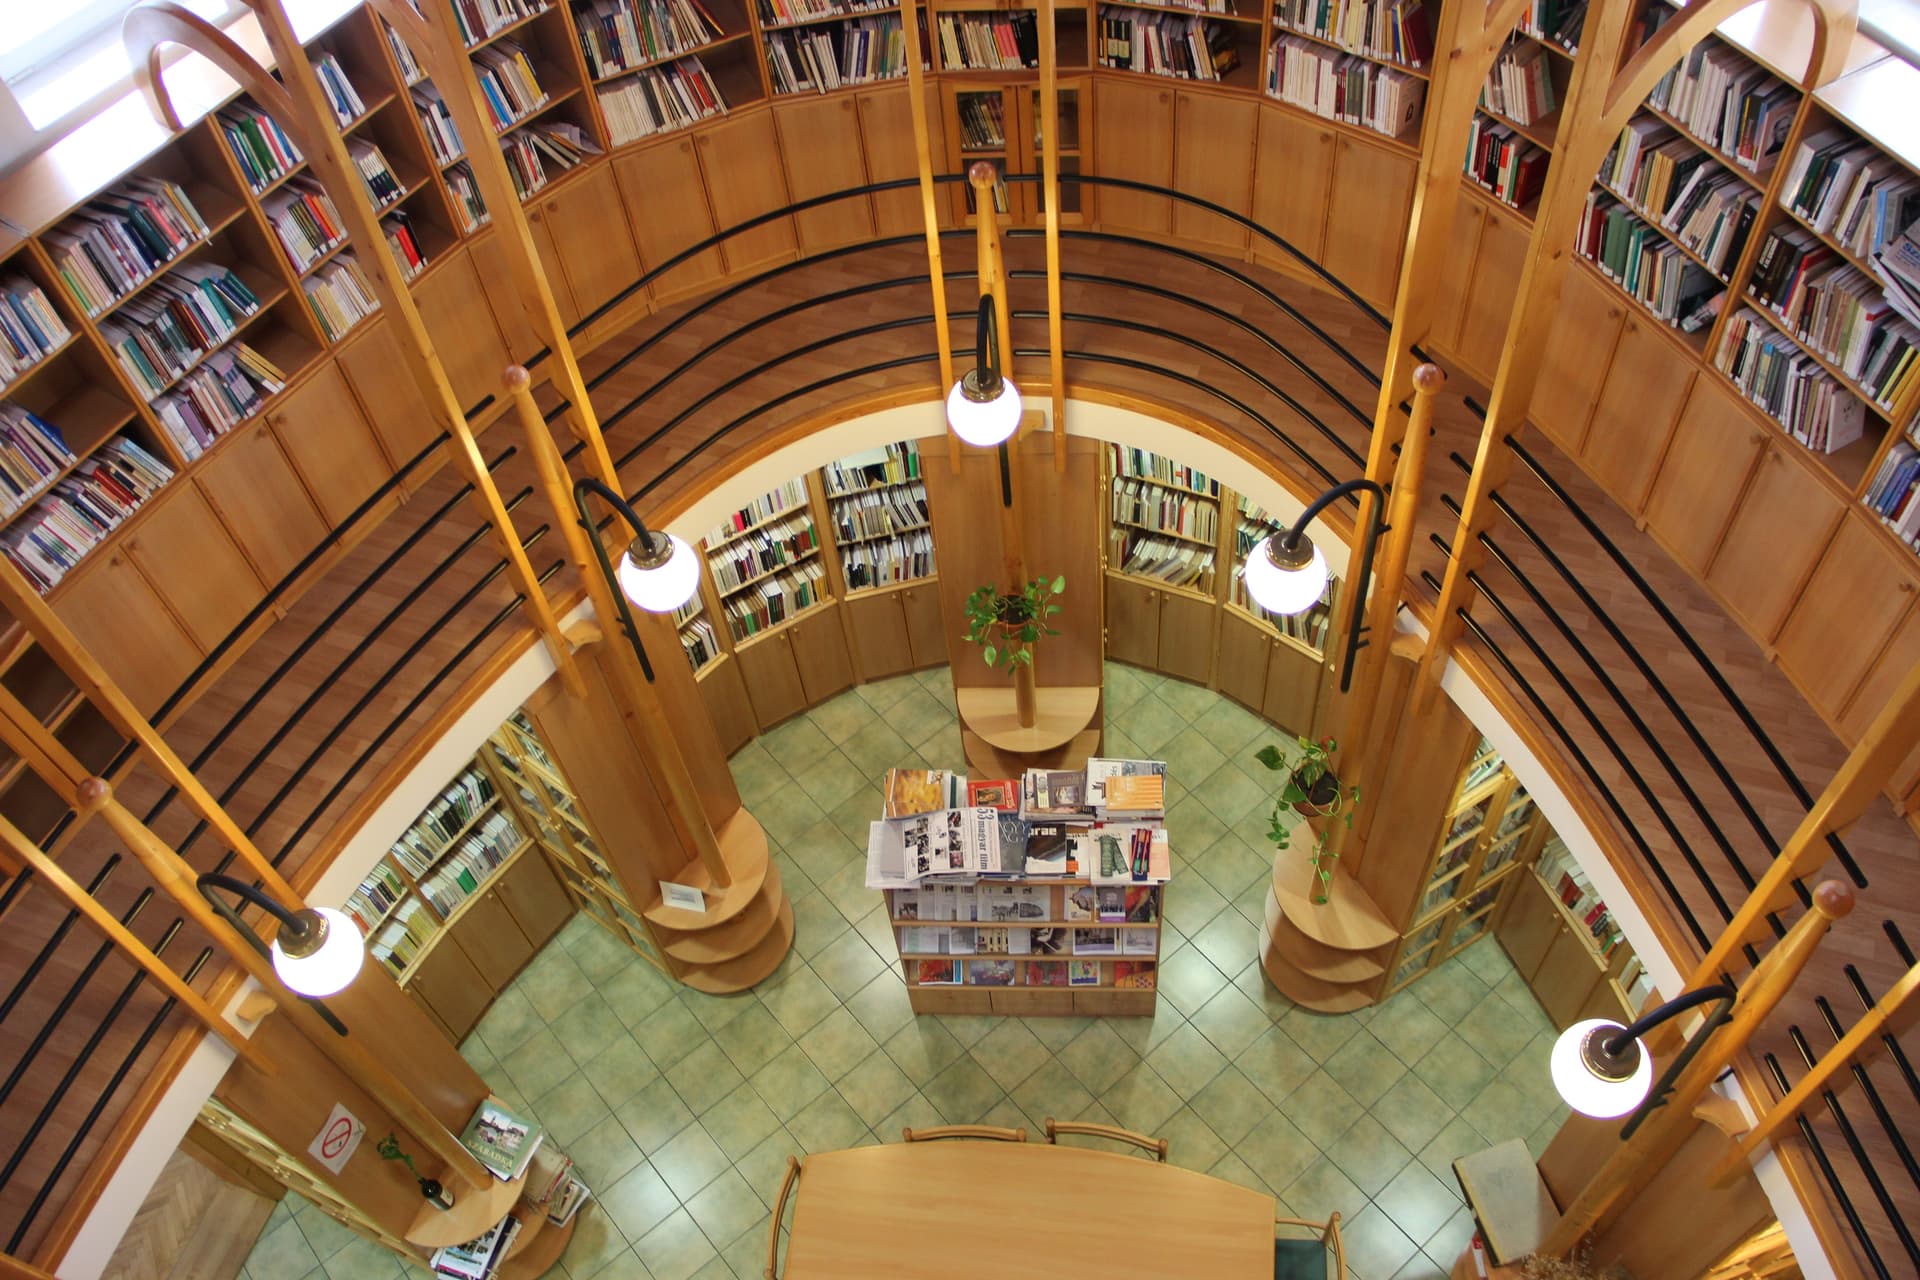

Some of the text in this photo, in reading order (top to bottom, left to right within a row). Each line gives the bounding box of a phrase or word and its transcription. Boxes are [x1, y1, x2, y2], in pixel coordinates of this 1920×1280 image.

[976, 808, 995, 820] 53
[977, 821, 987, 851] magyar
[980, 853, 988, 870] film
[466, 1139, 513, 1169] SZABADKA
